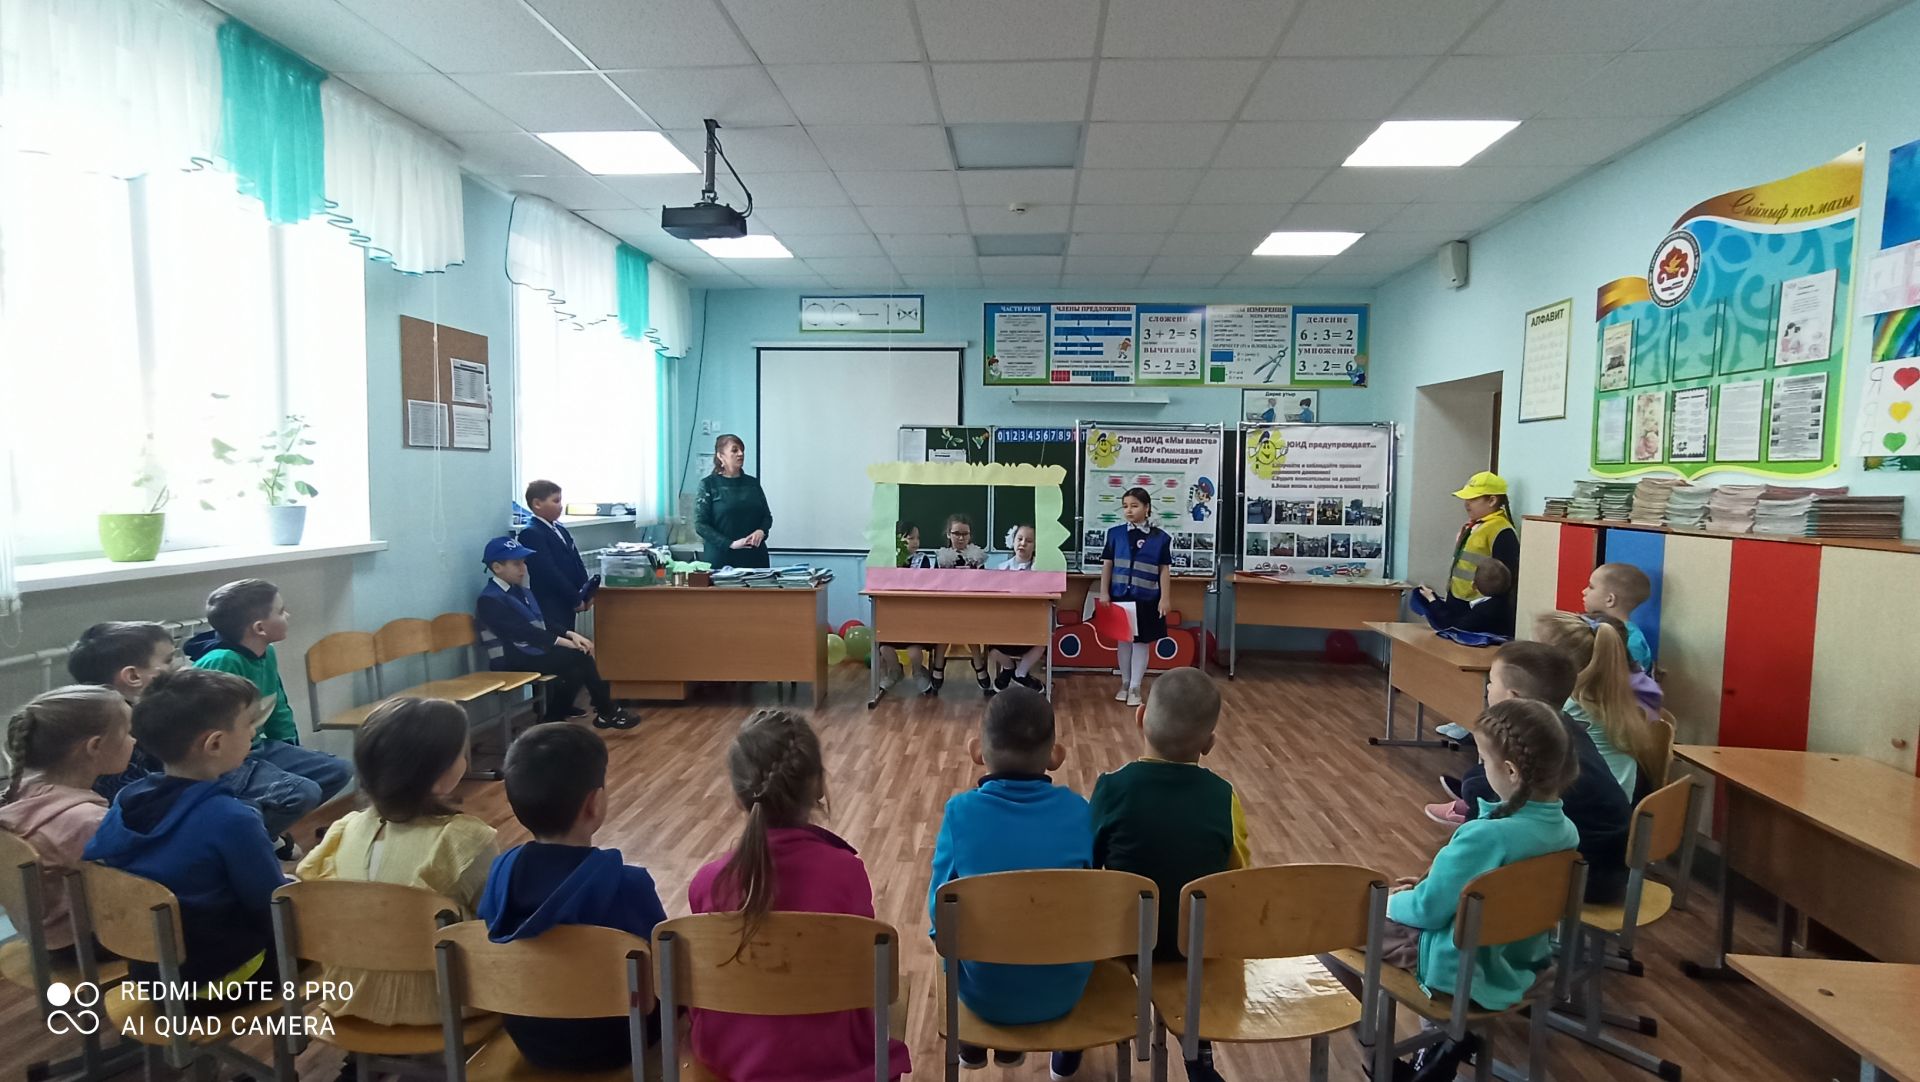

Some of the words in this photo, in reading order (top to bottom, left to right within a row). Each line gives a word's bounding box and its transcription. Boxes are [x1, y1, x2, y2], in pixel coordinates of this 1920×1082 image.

[1730, 193, 1788, 225] Сыйныф
[1307, 316, 1348, 324] деление
[1530, 308, 1565, 327] АЛФАВИТ
[1143, 329, 1151, 339] 3
[1189, 329, 1197, 339] 5
[1300, 329, 1308, 340] 6
[1346, 329, 1354, 340] 2
[1143, 360, 1151, 370] 5
[1164, 360, 1171, 370] 2
[1188, 360, 1196, 370] 3
[1298, 361, 1306, 371] 3
[1345, 361, 1353, 371] 6
[1117, 436, 1141, 444] Отряд
[1143, 436, 1163, 445] ЮИД
[1287, 441, 1307, 449] ЮИД
[1131, 446, 1154, 454] МБОУ
